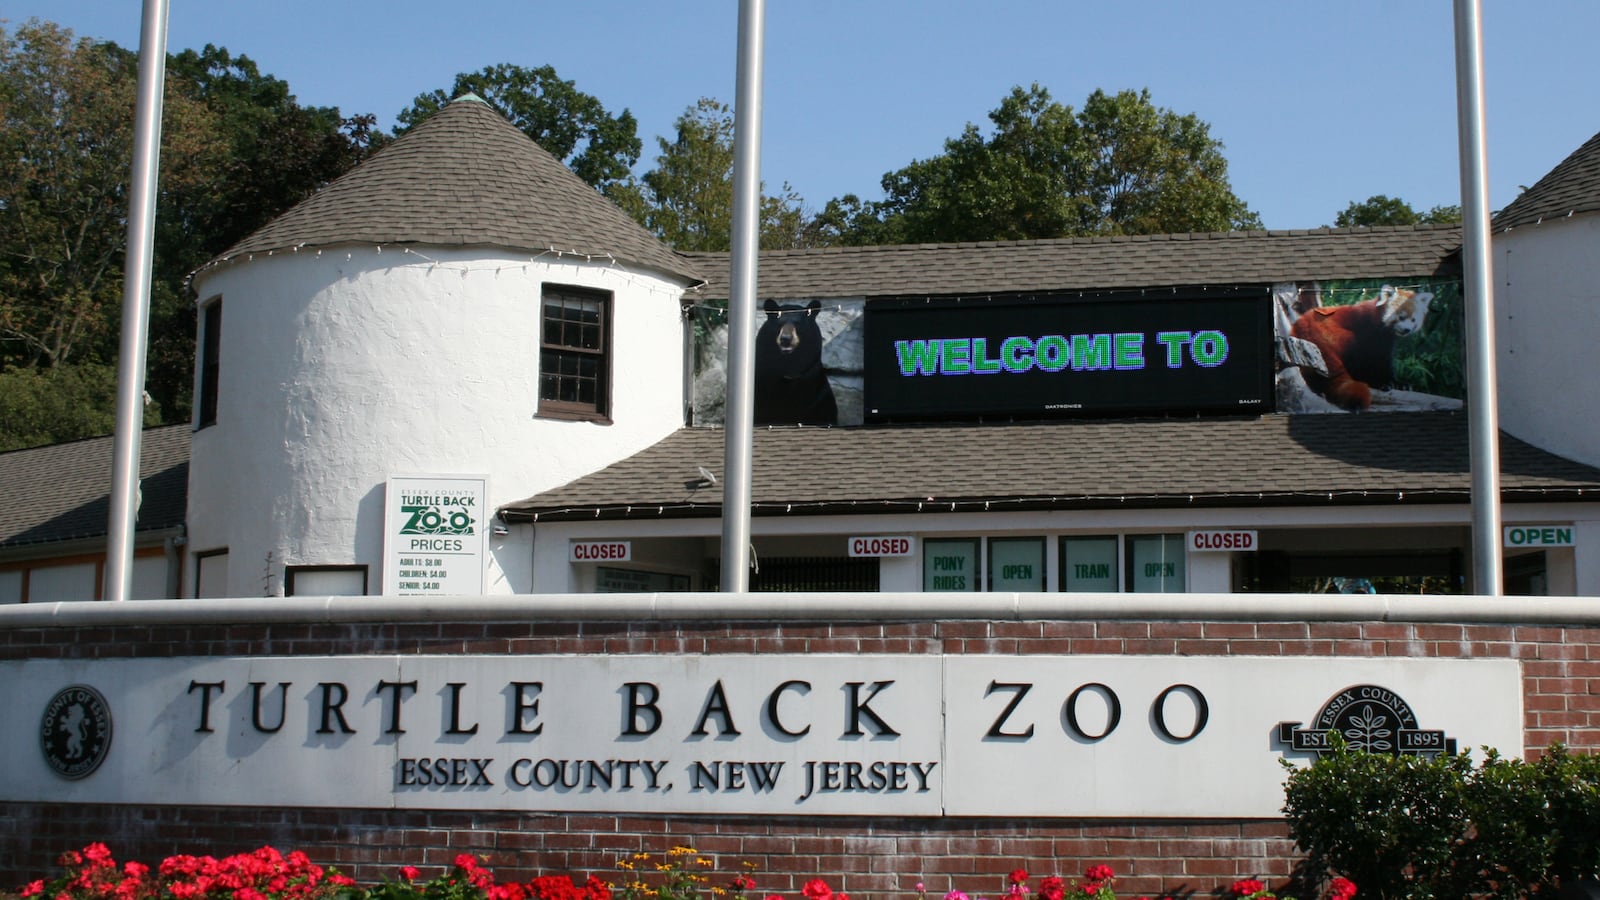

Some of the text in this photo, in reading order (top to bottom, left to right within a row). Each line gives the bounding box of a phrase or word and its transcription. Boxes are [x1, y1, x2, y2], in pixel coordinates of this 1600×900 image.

[895, 330, 1229, 377] WELCOME TO
[401, 495, 475, 506] TURTLE BACK
[1194, 532, 1253, 549] CLOSED
[1509, 528, 1571, 545] OPEN
[411, 539, 463, 551] PRICES
[574, 543, 627, 559] CLOSED
[853, 538, 909, 554] CLOSED
[934, 556, 965, 572] PONY
[1002, 564, 1032, 580] OPEN
[1074, 563, 1110, 579] TRAIN
[1144, 562, 1175, 578] OPEN
[422, 582, 440, 590] $4.00
[933, 575, 966, 591] RIDES
[188, 679, 1209, 741] TURTLE BACK ZOO
[1321, 686, 1414, 726] ESSEX COUNTY
[1301, 731, 1440, 747] EST. 1895
[400, 758, 938, 801] ESSEX COUNTY, NEW JERSEY
